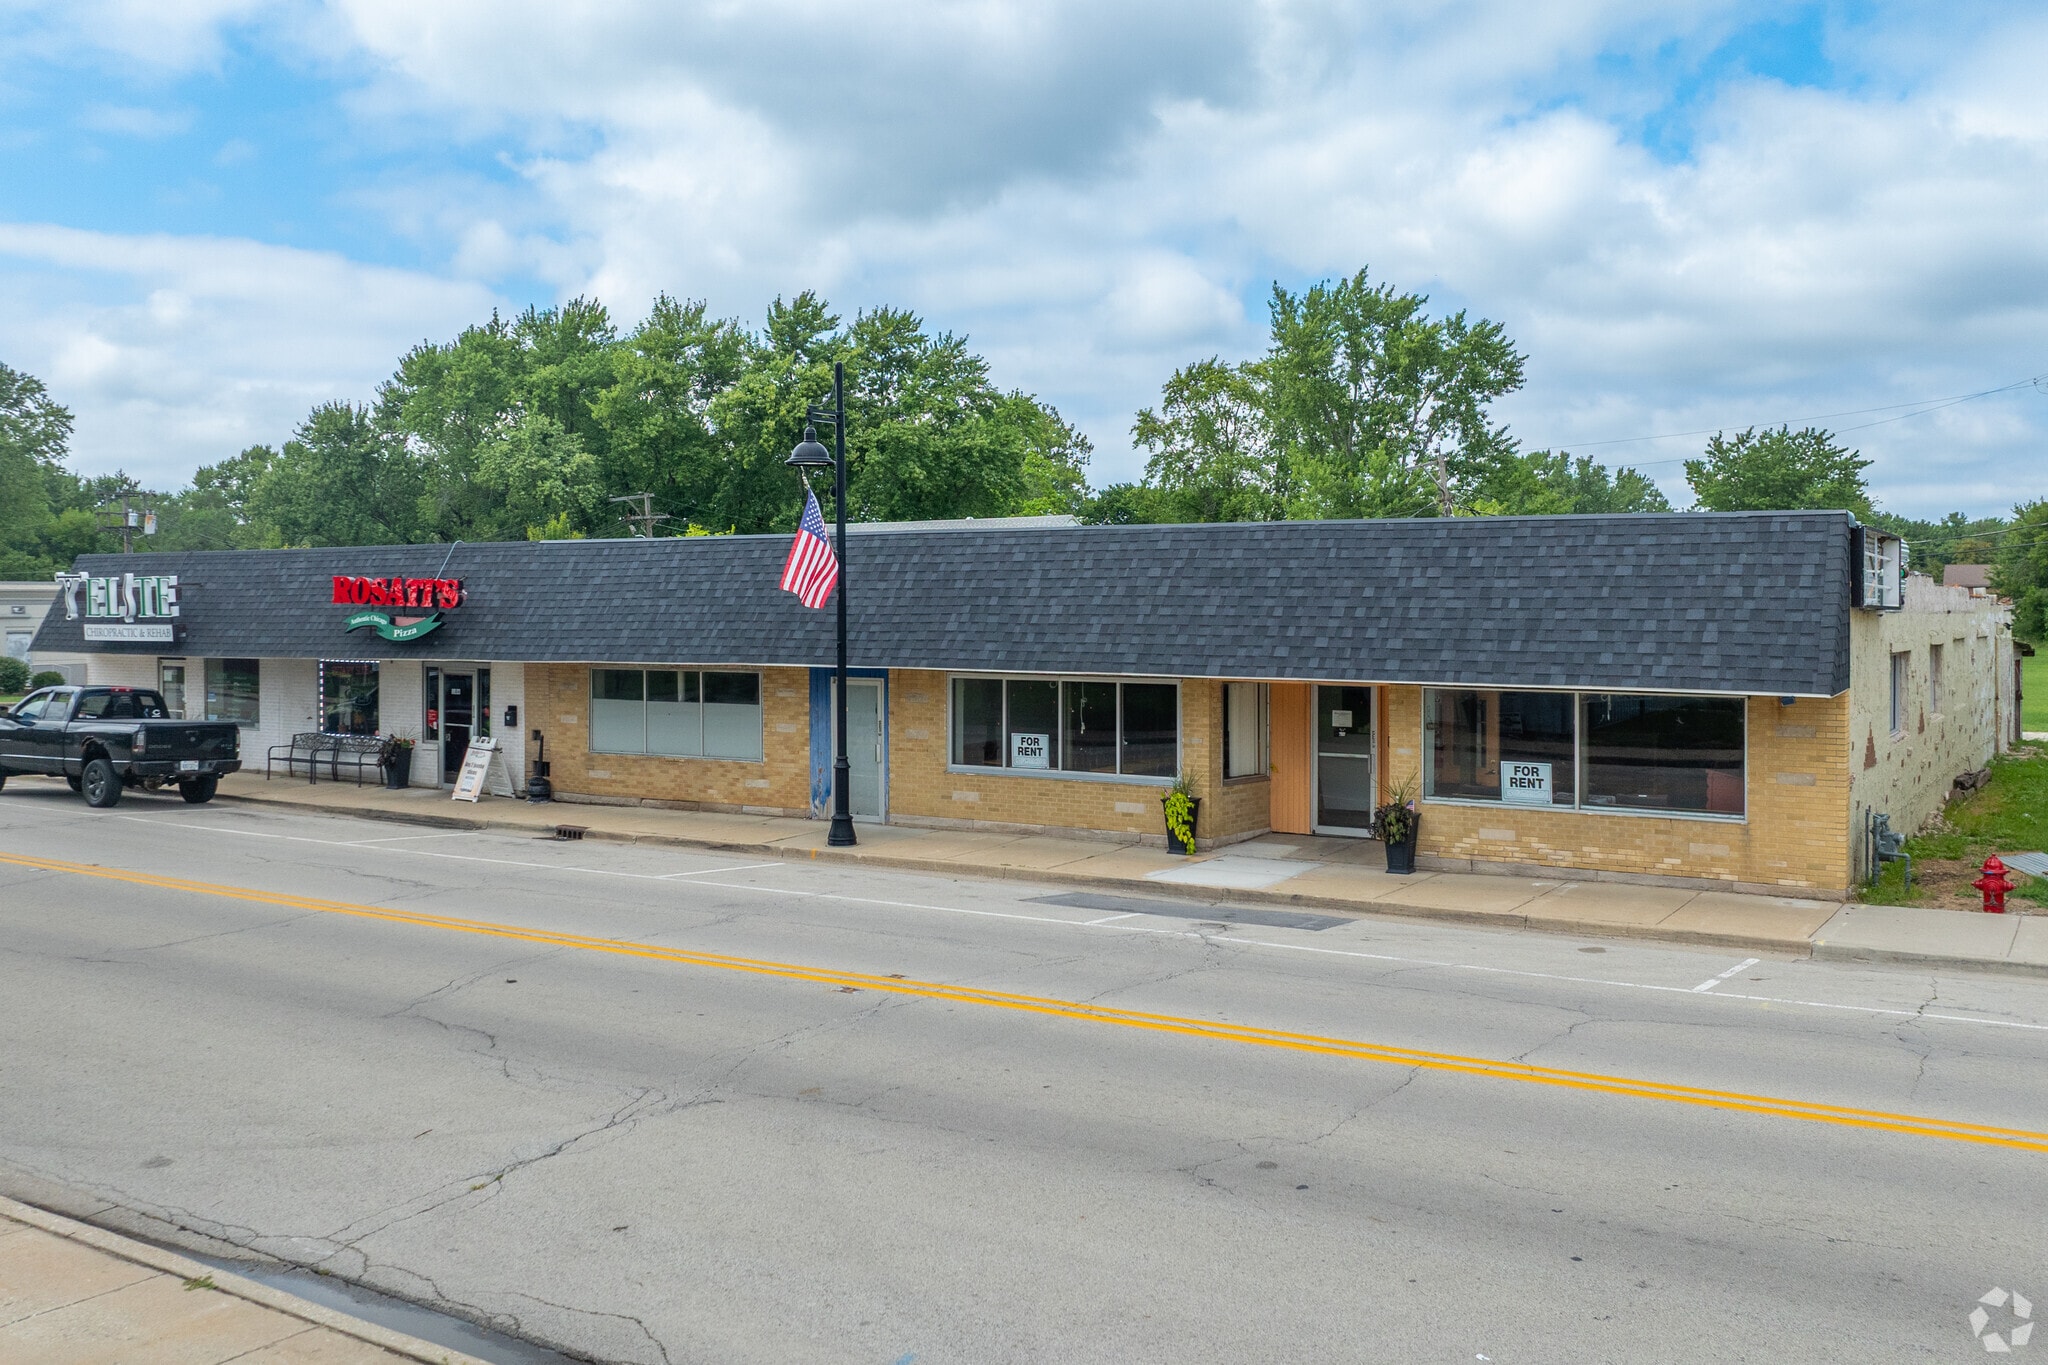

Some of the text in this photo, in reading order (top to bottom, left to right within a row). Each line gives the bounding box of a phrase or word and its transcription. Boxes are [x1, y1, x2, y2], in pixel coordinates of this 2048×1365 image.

[86, 628, 171, 638] CHIROPRACTIC & REHAB
[393, 628, 417, 637] Pizza
[1021, 737, 1040, 746] FOR
[1018, 747, 1043, 756] RENT
[1514, 766, 1539, 777] FOR
[1510, 777, 1544, 789] RENT
